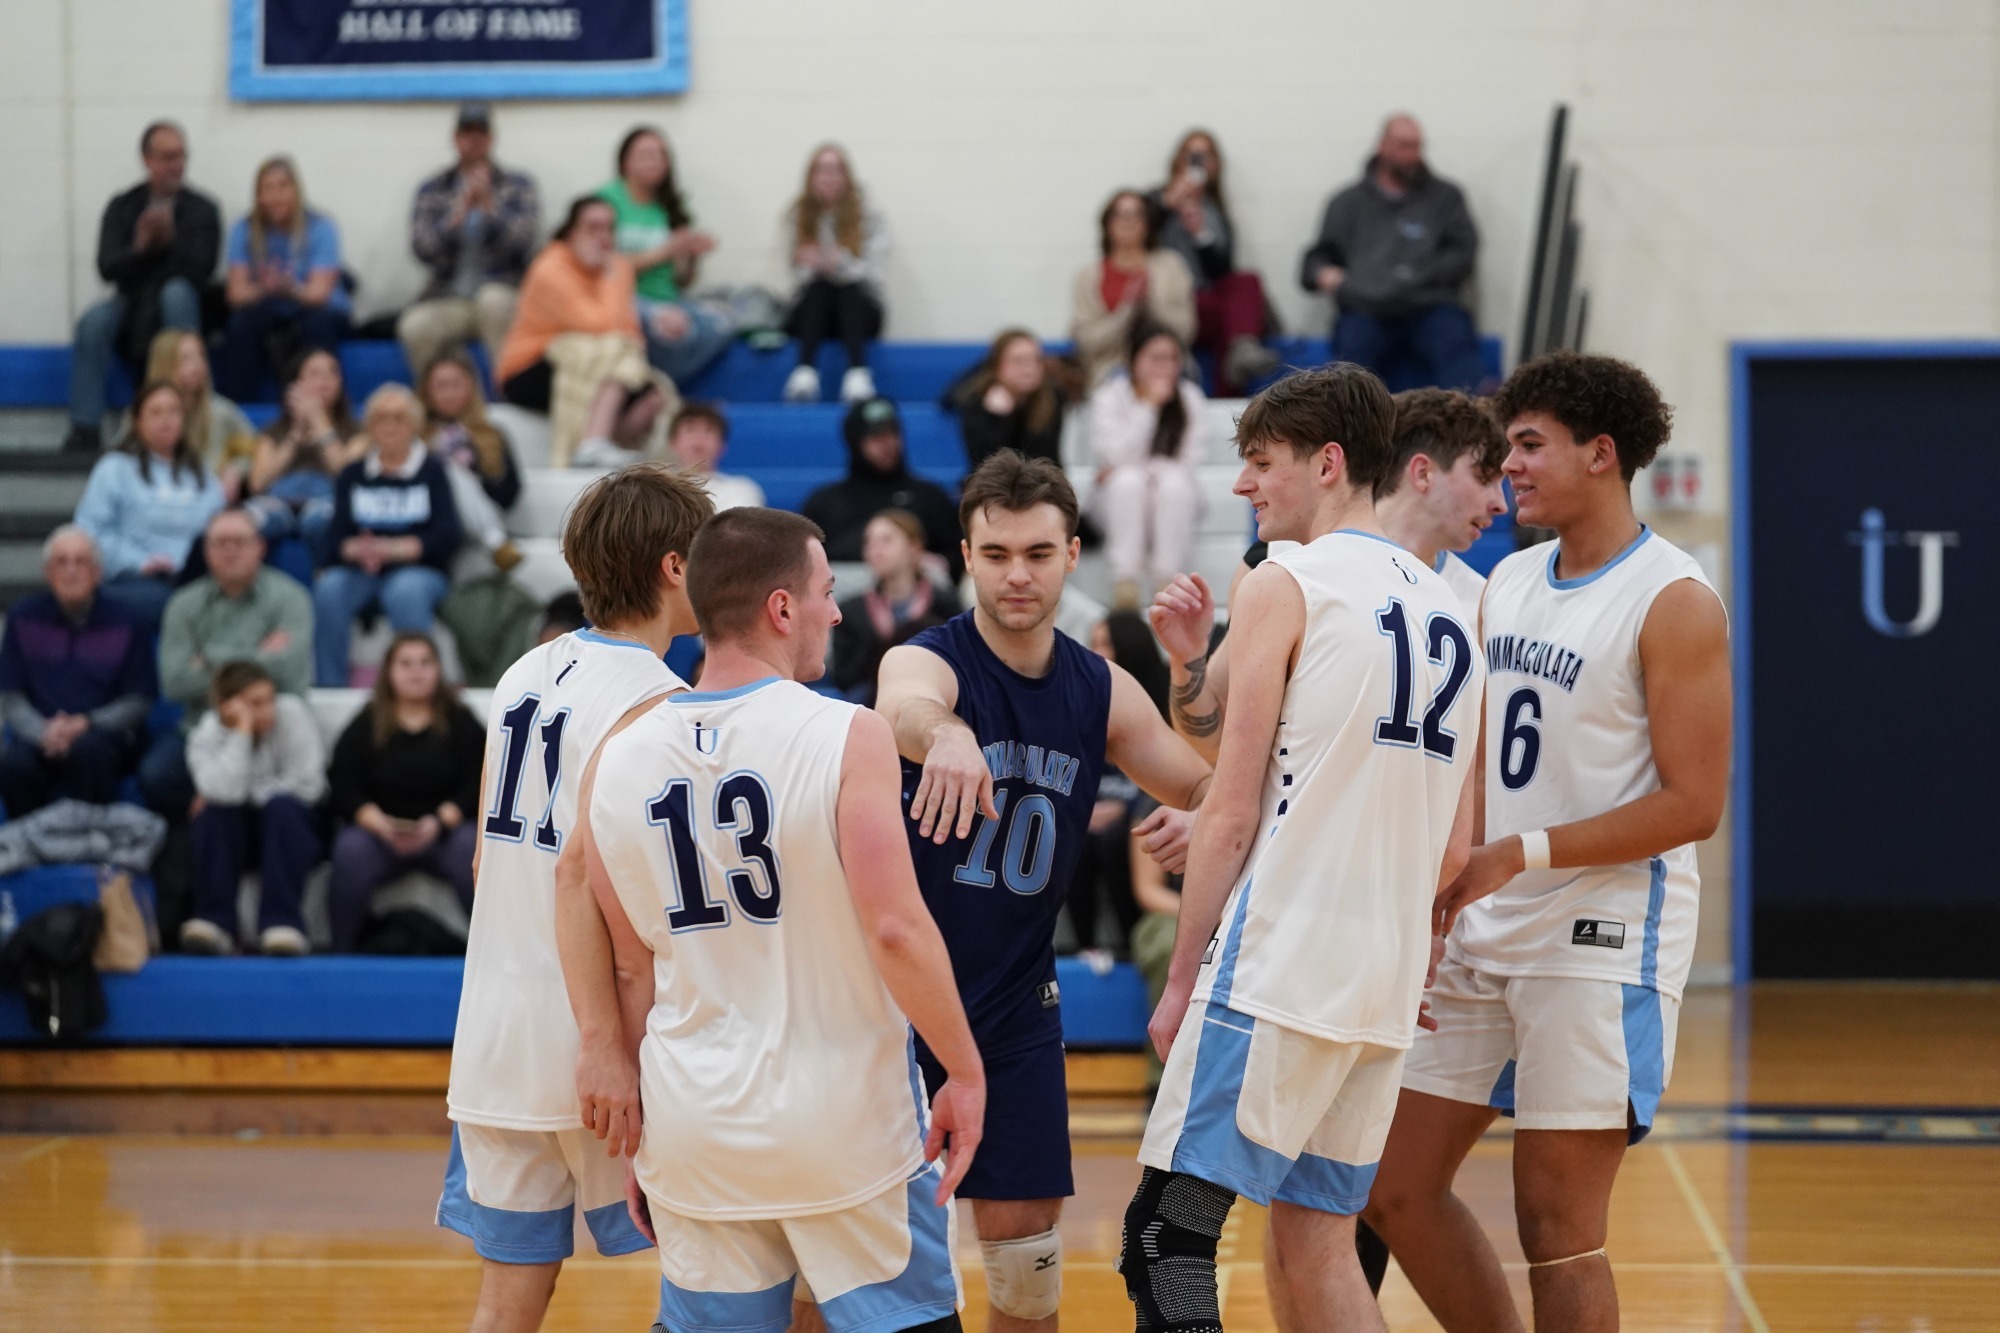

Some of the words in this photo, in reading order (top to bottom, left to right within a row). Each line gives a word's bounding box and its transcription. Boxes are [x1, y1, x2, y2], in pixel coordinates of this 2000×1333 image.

[338, 9, 429, 43] HALL
[432, 7, 484, 41] OF
[485, 7, 583, 41] FAME
[1373, 595, 1474, 764] 12
[1486, 634, 1586, 694] IMMACULATA
[484, 692, 572, 855] 11
[1500, 685, 1542, 792] 6
[646, 769, 782, 934] 13
[953, 788, 1057, 896] 10
